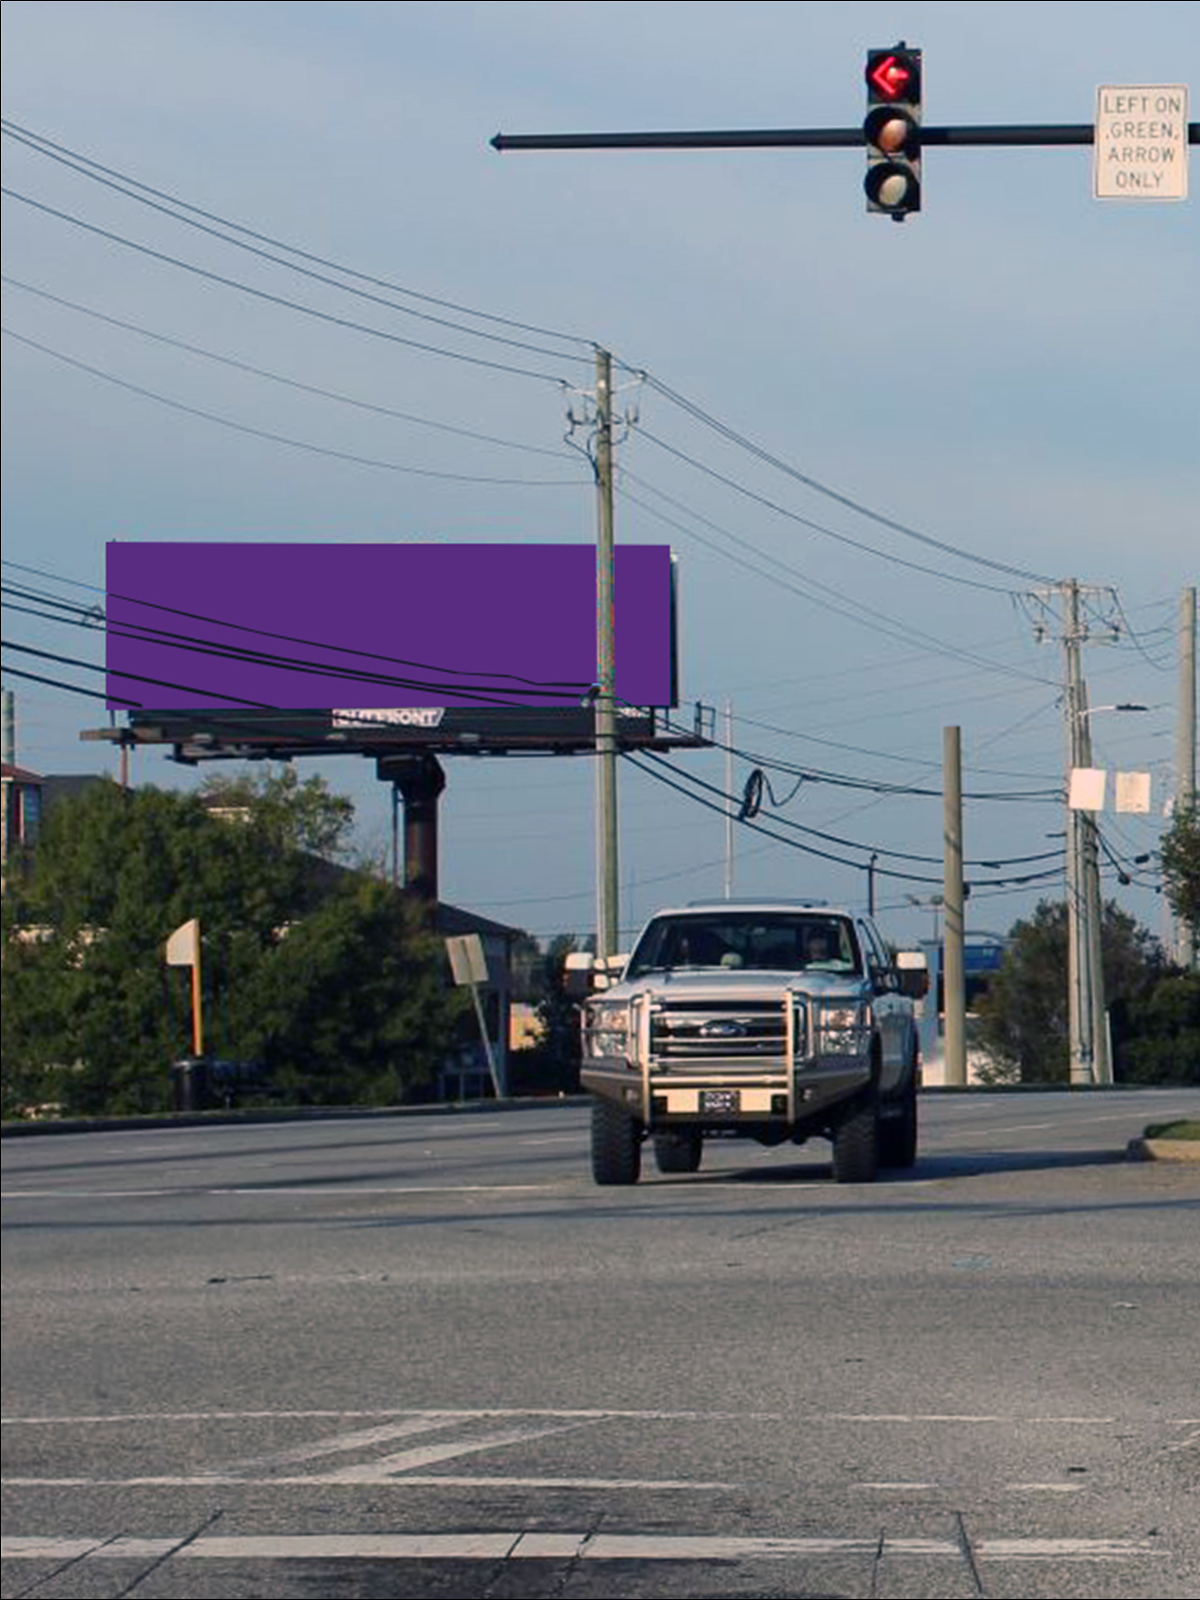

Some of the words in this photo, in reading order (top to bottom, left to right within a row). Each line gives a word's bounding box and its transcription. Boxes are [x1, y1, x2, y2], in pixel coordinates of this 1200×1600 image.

[1103, 96, 1147, 114] LEFT
[1155, 96, 1181, 114] ON
[1108, 146, 1175, 163] ARROW
[1115, 170, 1164, 188] ONLY
